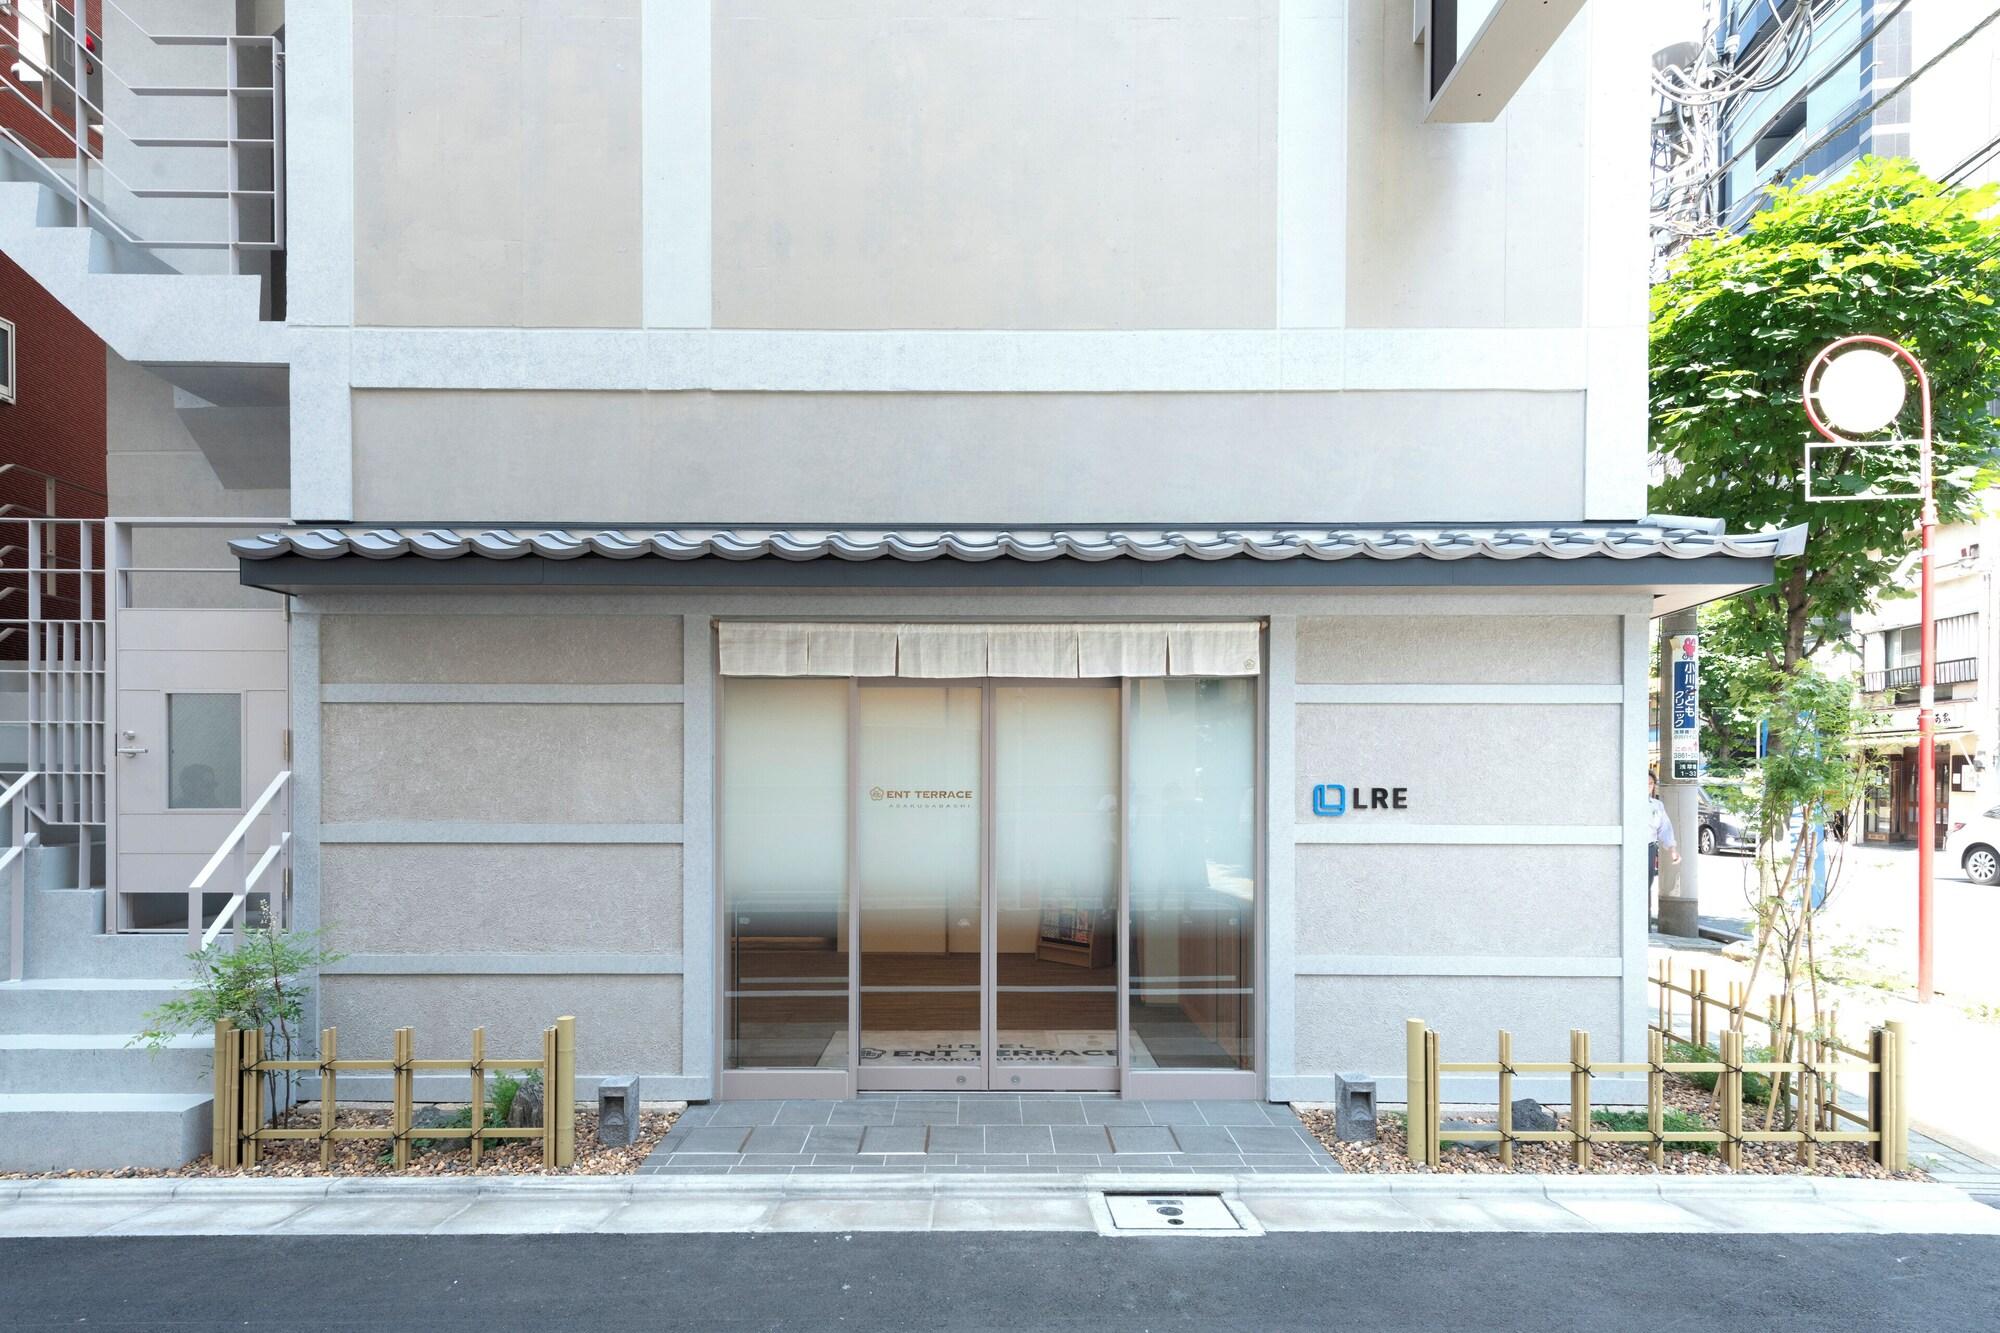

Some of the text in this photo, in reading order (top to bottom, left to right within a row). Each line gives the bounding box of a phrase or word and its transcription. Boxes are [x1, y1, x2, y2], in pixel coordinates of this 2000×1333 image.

[1684, 662, 1696, 717] 小川こども
[1675, 690, 1684, 727] クリニック
[886, 790, 973, 799] ENT TERRACE
[1353, 788, 1408, 809] LRE
